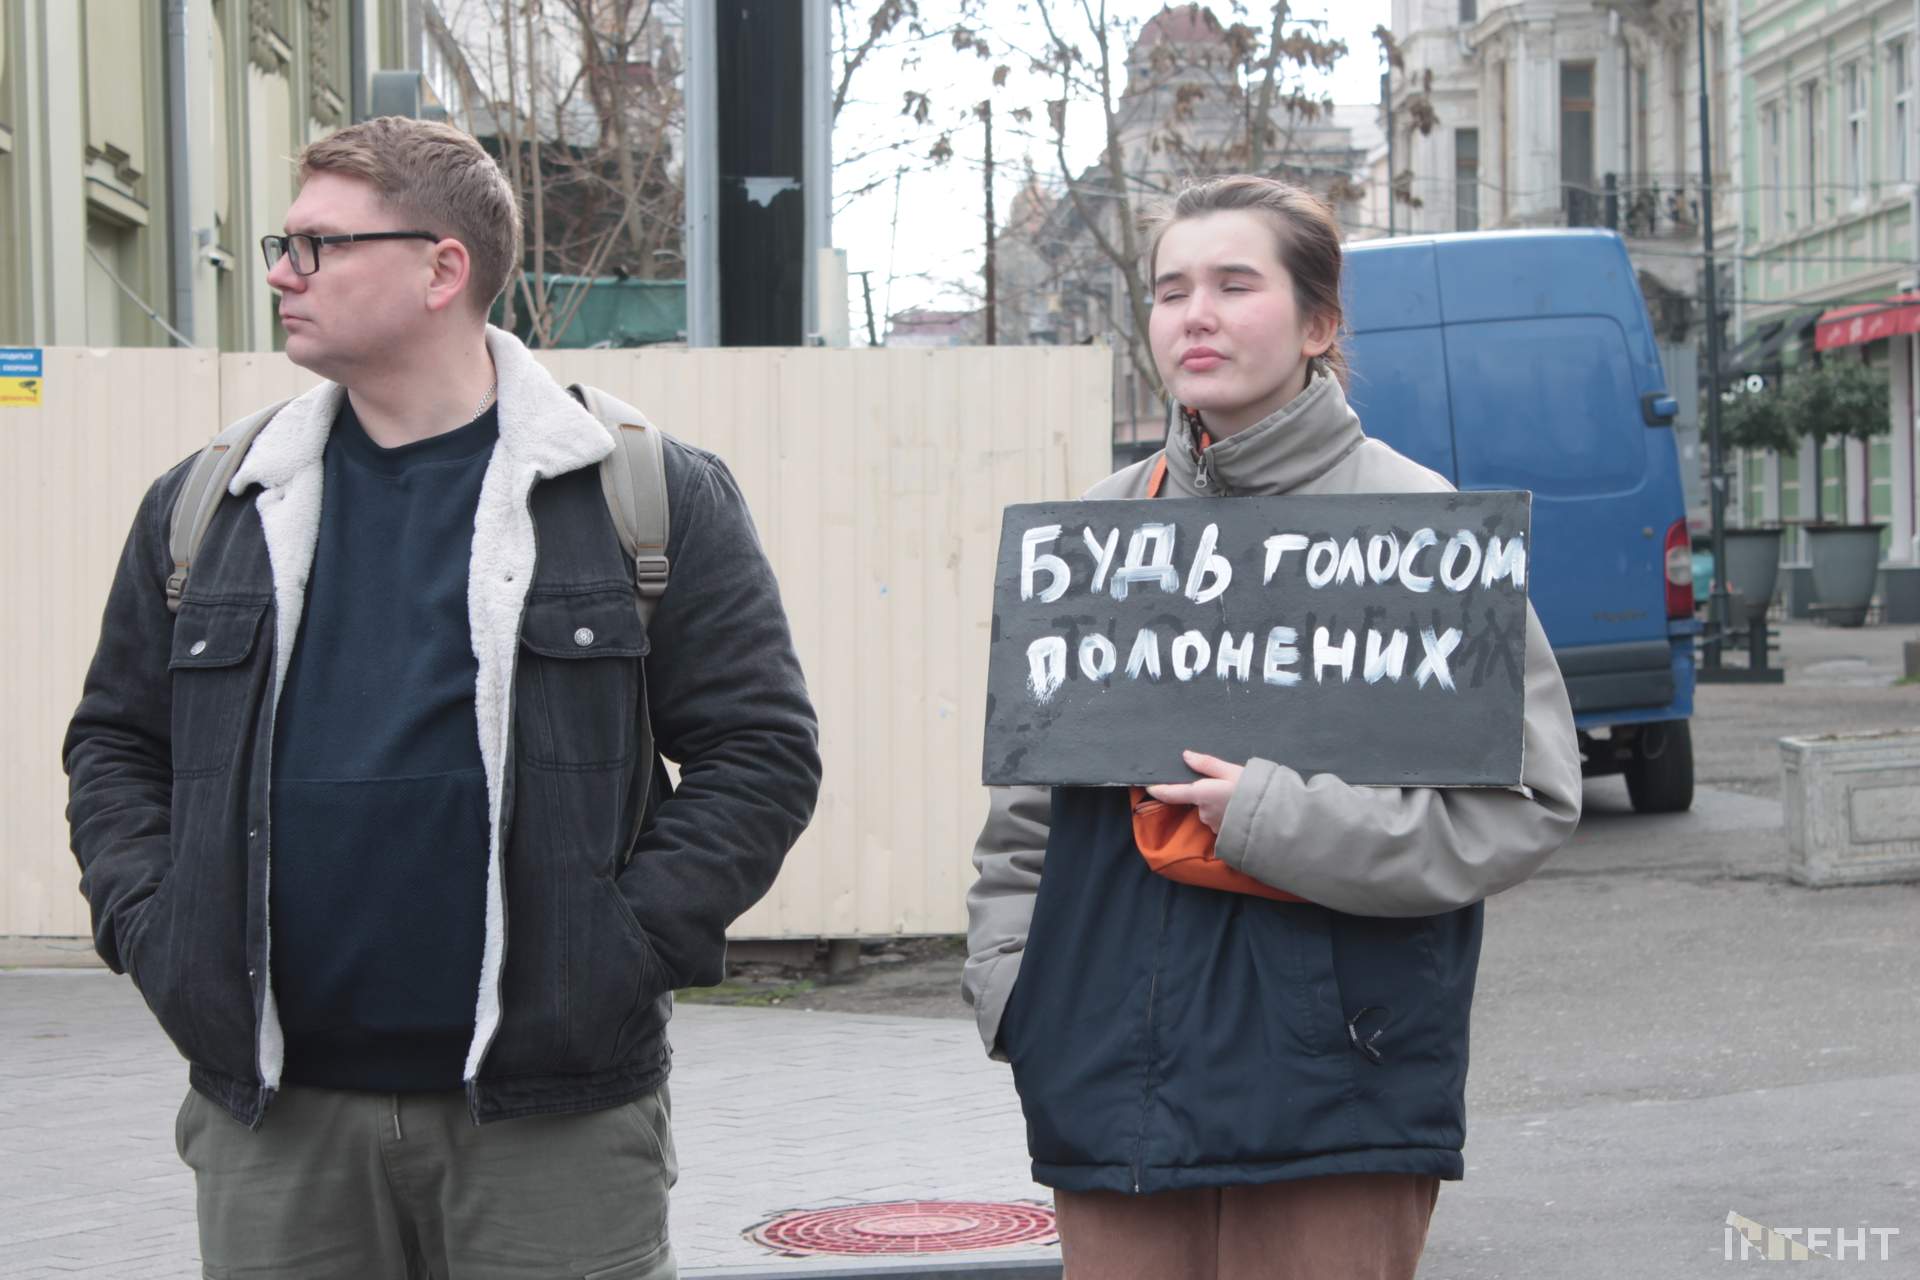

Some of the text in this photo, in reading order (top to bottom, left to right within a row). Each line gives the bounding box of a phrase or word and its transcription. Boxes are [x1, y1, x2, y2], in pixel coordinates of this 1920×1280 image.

[1020, 523, 1526, 603] БУДЬ ГОЛОСОМ
[1027, 624, 1462, 704] ПОЛОНЕНИХ
